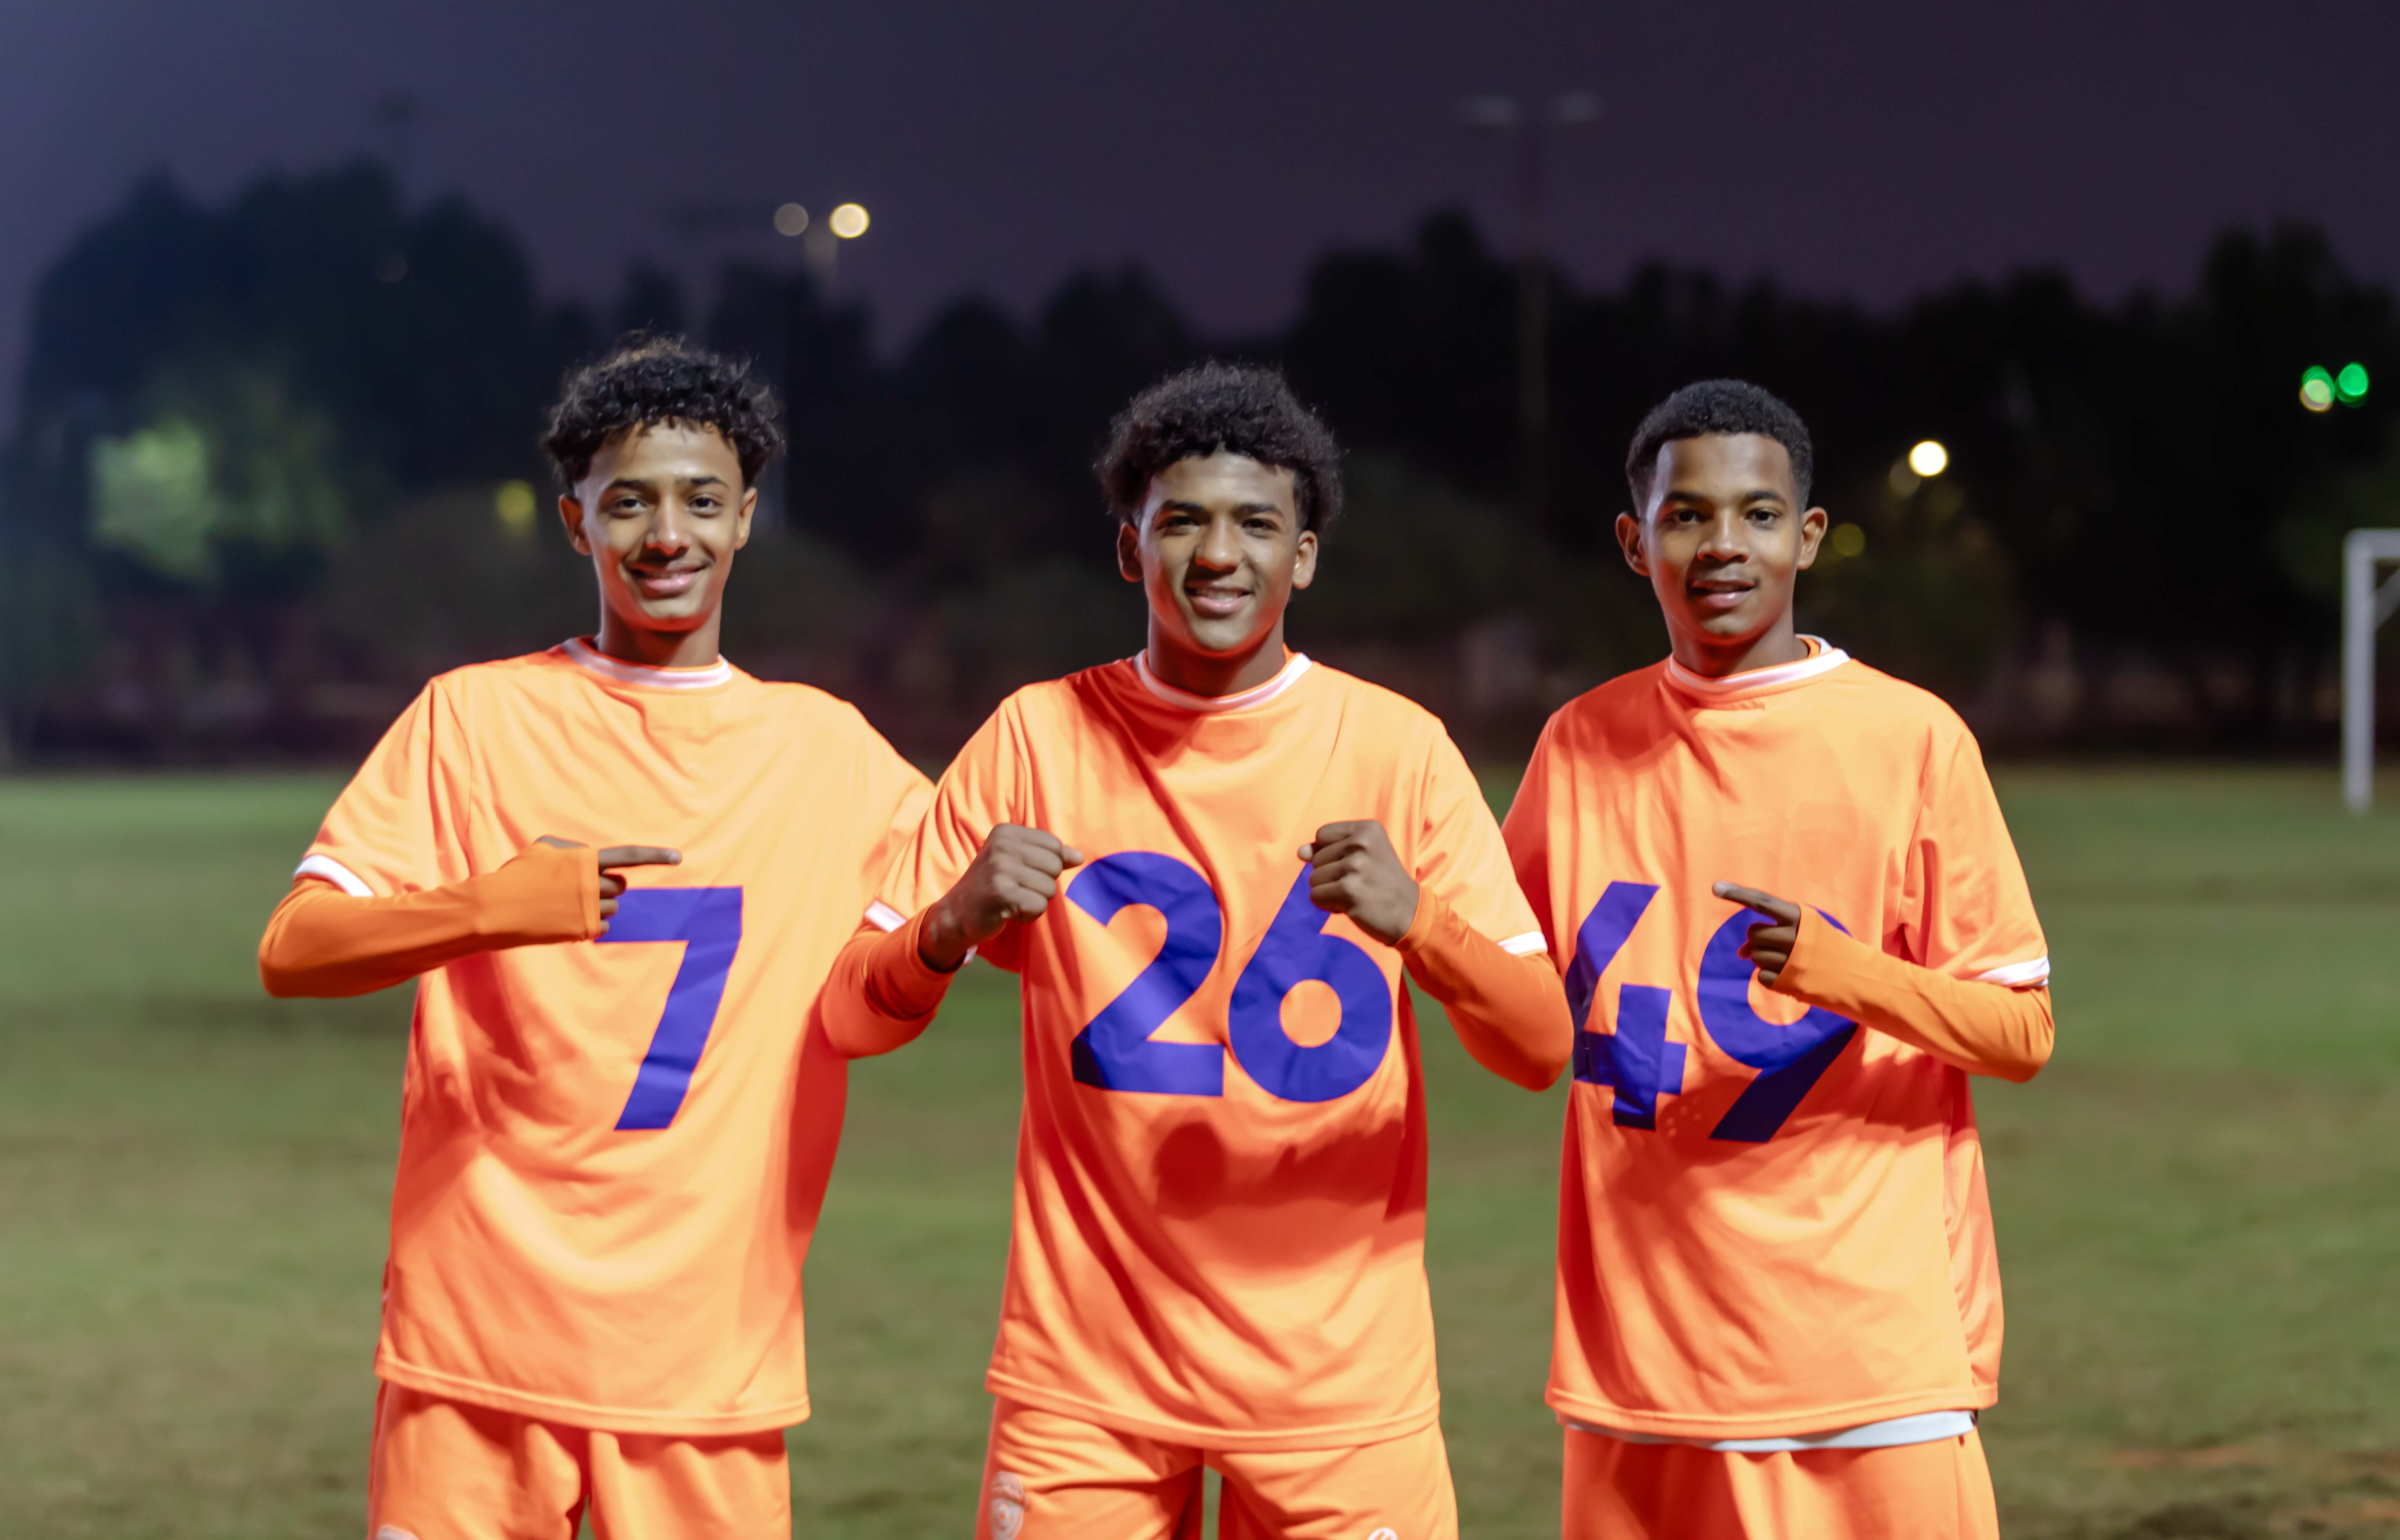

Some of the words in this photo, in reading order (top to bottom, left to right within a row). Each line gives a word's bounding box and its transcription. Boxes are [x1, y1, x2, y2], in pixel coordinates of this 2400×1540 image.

[593, 886, 743, 1130] 7
[1065, 851, 1393, 1103] 26
[1566, 881, 1859, 1143] 49
